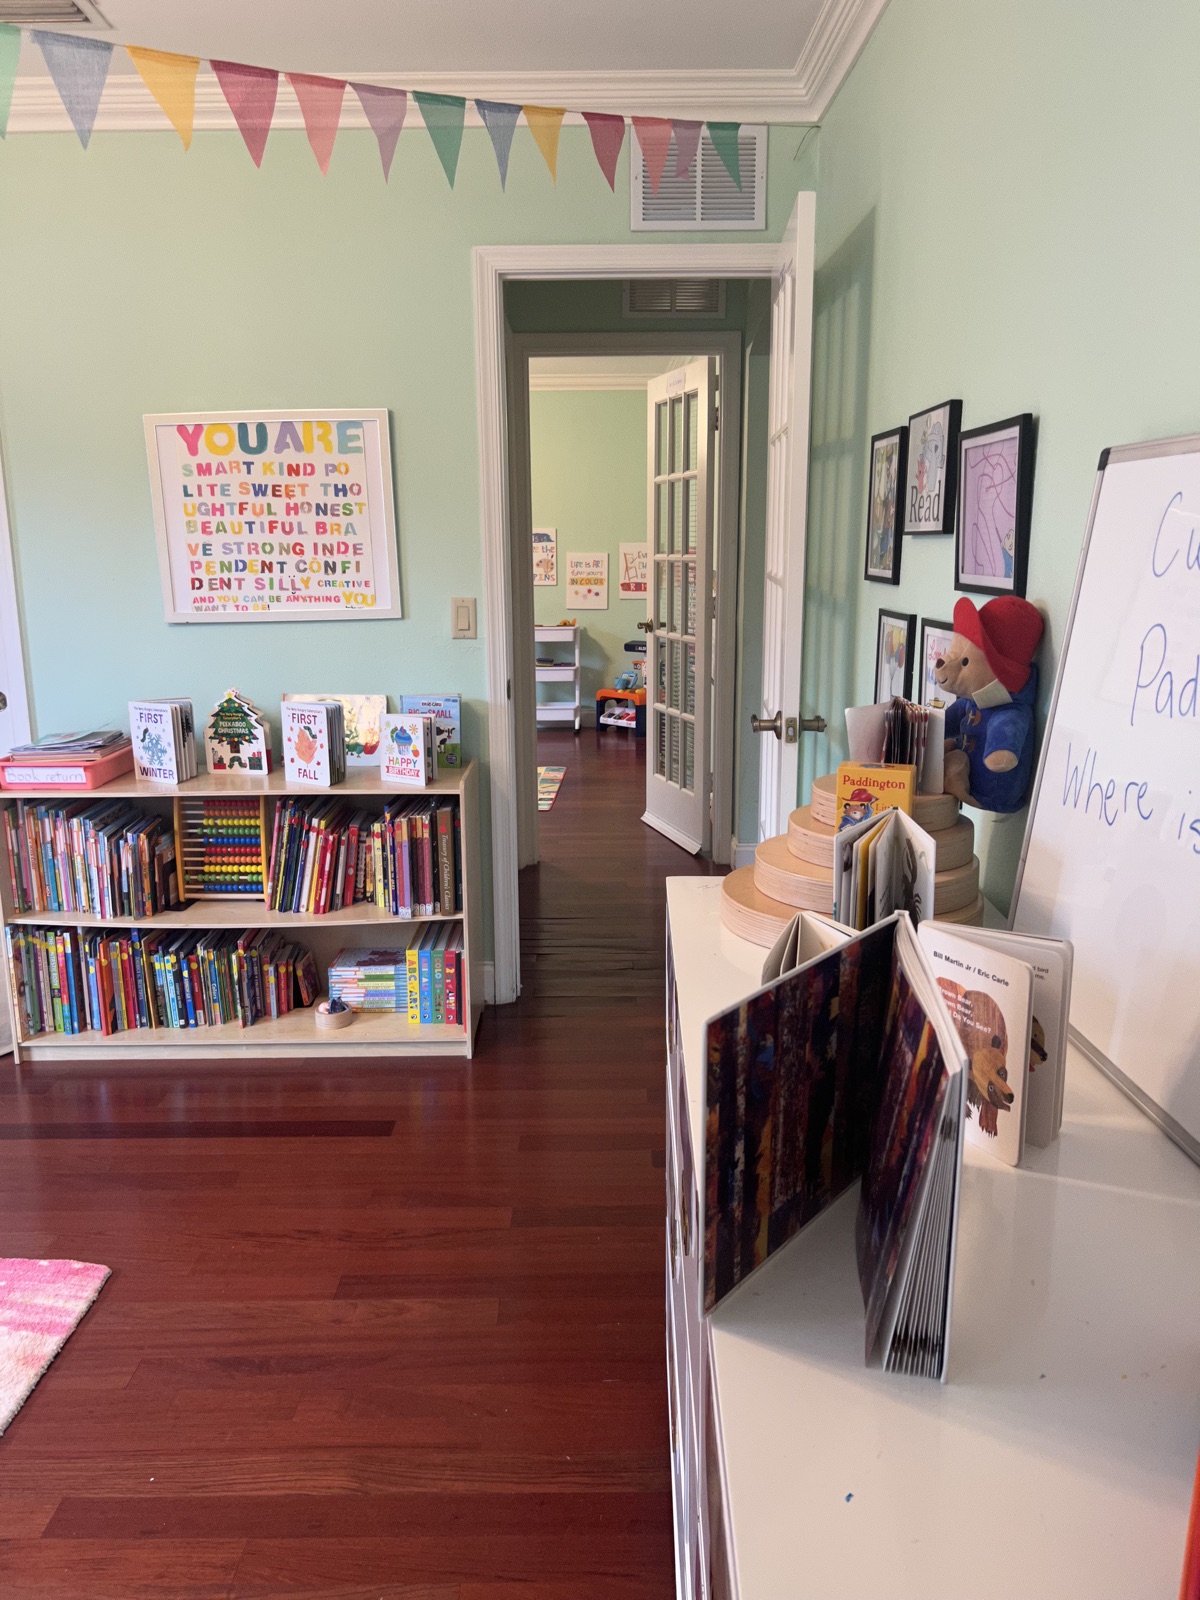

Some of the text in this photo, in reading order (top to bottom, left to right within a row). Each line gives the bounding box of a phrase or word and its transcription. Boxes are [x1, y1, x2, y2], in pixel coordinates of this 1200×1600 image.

[176, 420, 363, 457] YOU ARE
[182, 460, 350, 477] SMART KIND PO
[182, 481, 362, 499] LITE SWEET THO
[909, 480, 942, 523] Read
[183, 502, 366, 518] UGHTFUL HONEST
[185, 520, 358, 536] BEAUTIFUL BRA
[187, 541, 364, 557] VE STRONG INDE
[190, 558, 361, 576] PENDENT CONFI
[190, 575, 371, 592] DENT SILLY CREATIVE
[192, 596, 215, 604] AND
[216, 595, 239, 603] YOU
[242, 595, 265, 603] CAN
[268, 595, 282, 603] BE
[286, 594, 341, 604] ANYTHING
[342, 591, 376, 608] YOU
[194, 604, 228, 612] WANT
[234, 604, 249, 612] TO
[140, 712, 163, 724] FIRST
[292, 713, 317, 725] FIRST
[388, 756, 417, 768] HAPPY
[46, 771, 83, 781] return
[140, 766, 175, 779] WINTER
[298, 768, 318, 780] FALL
[389, 767, 418, 777] BIRTHDAY
[843, 775, 905, 791] Paddington
[1063, 742, 1153, 826] Where
[443, 864, 451, 889] Children's
[50, 949, 58, 972] NTASTIC
[933, 951, 943, 959] Bill
[944, 955, 964, 968] Martin
[977, 969, 990, 979] Eric
[992, 975, 1009, 986] Carle
[409, 990, 418, 1010] ART
[958, 994, 973, 1007] Bear,
[957, 1004, 973, 1017] Bear,
[953, 1011, 961, 1020] Do
[963, 1016, 974, 1026] You
[976, 1021, 991, 1033] See?
